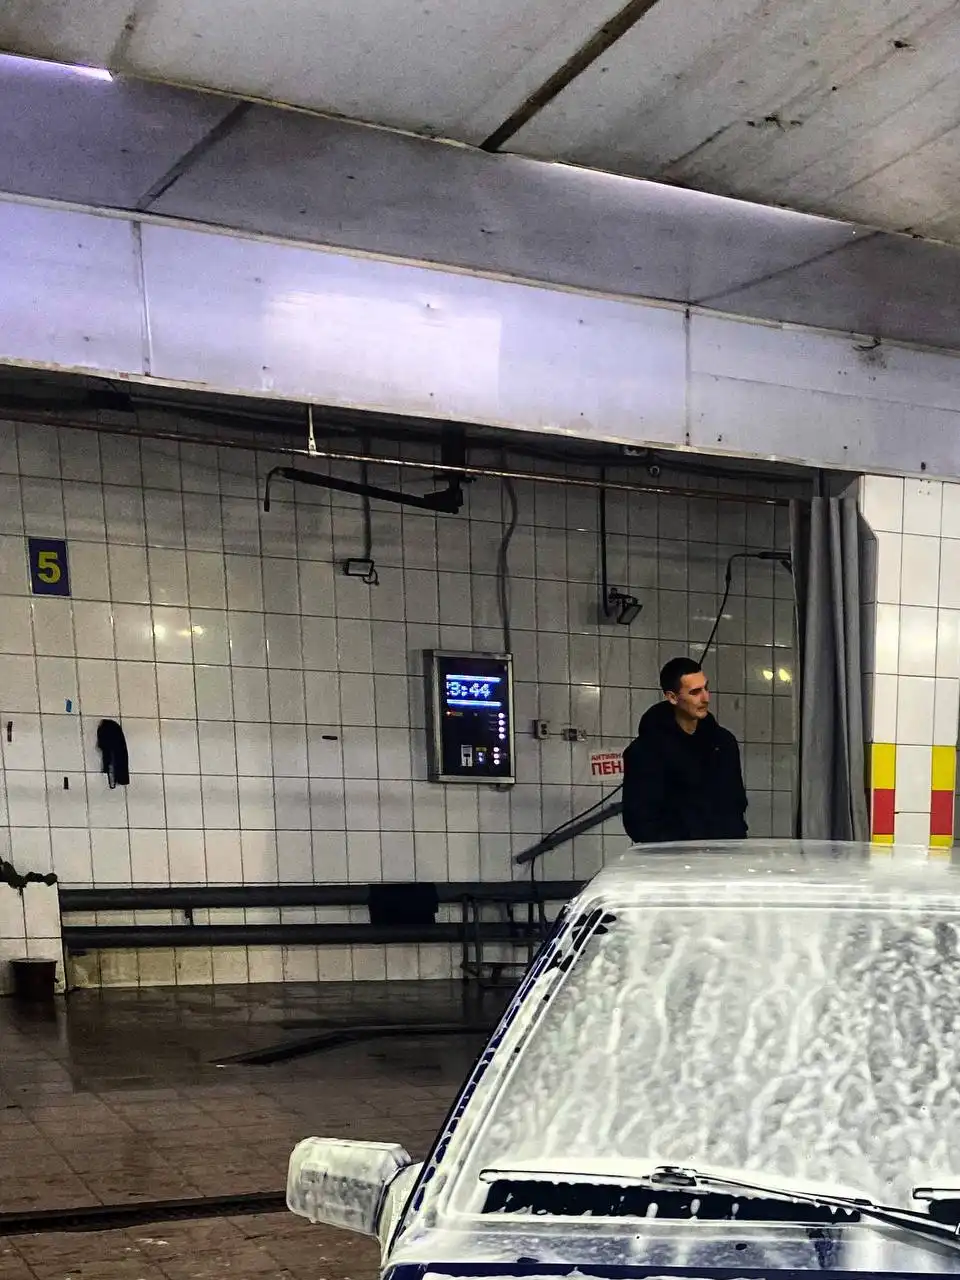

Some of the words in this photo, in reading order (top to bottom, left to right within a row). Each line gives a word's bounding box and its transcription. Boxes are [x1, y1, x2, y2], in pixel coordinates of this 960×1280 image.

[38, 551, 61, 584] 5
[446, 681, 491, 698] 3:44
[592, 761, 624, 775] ПЕН
